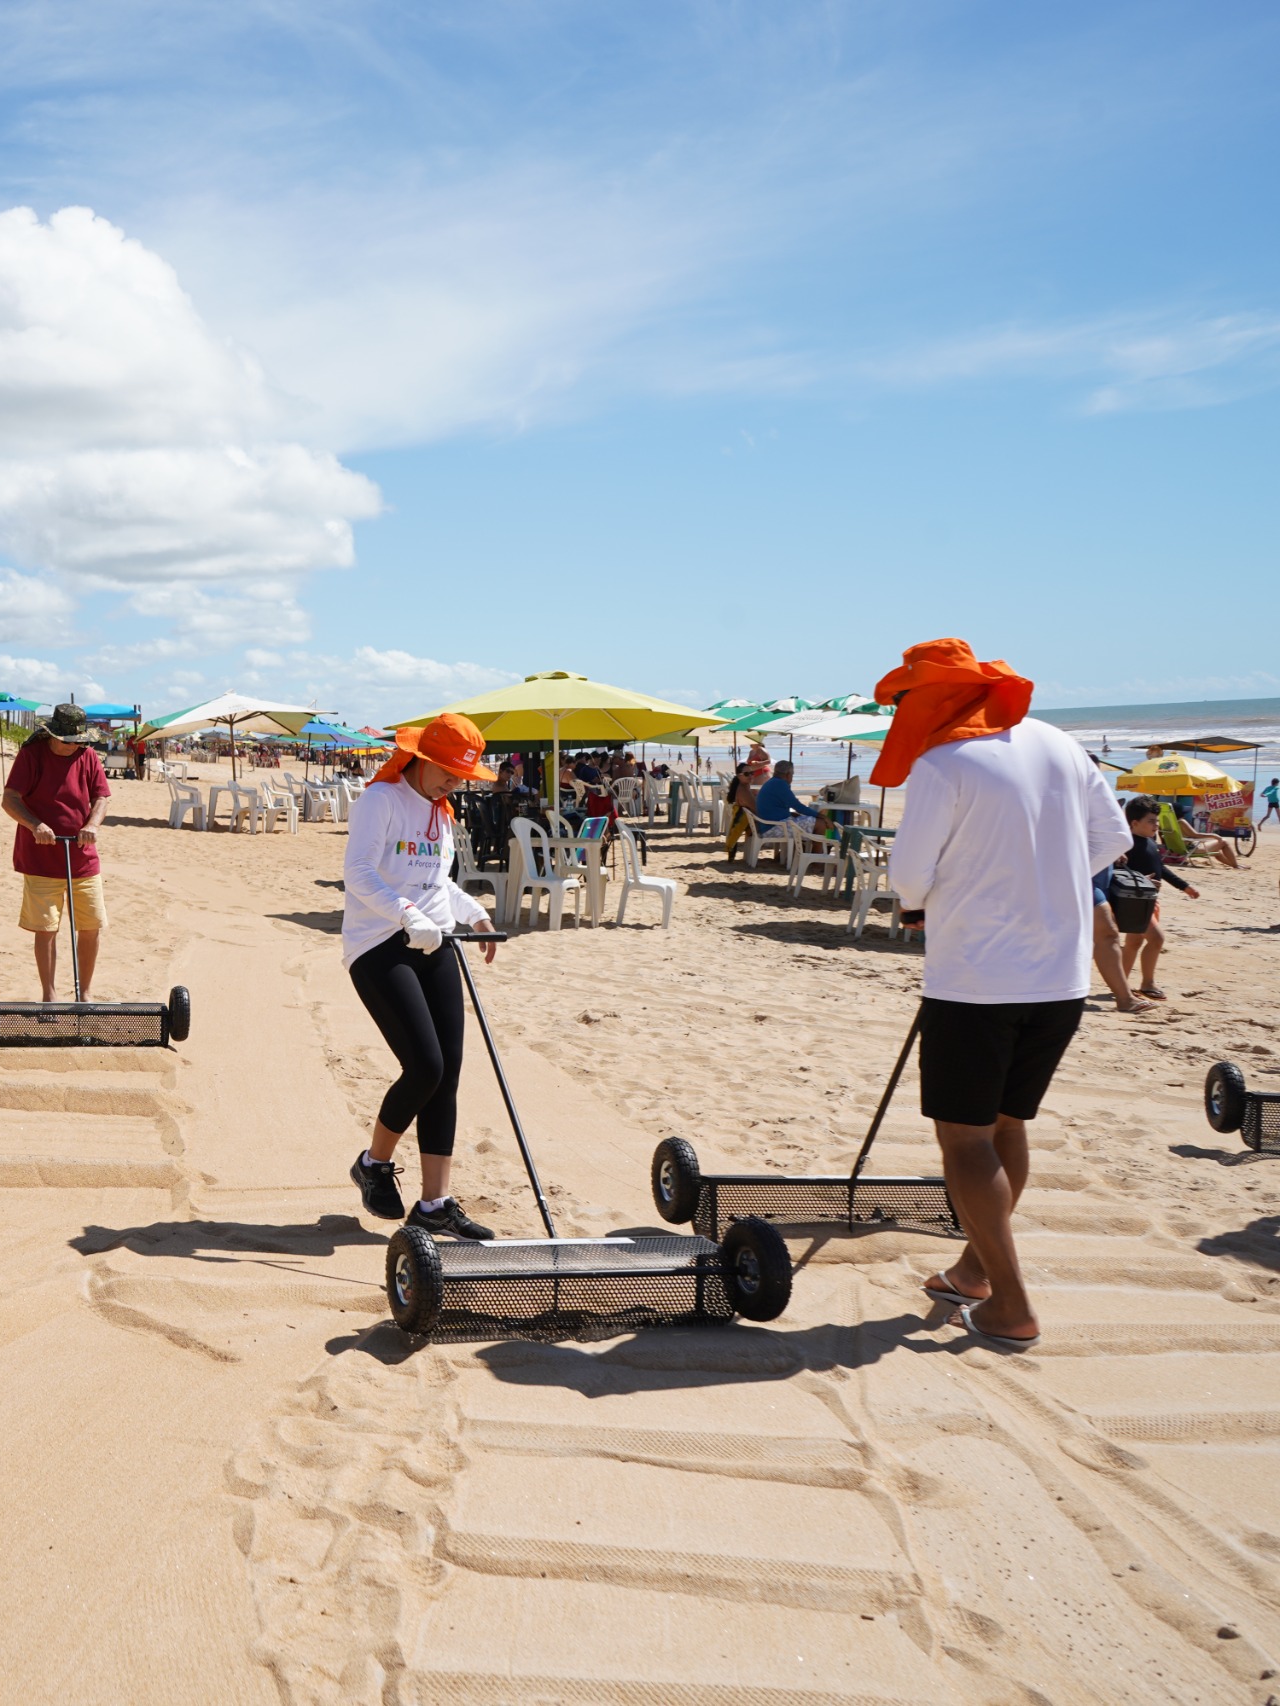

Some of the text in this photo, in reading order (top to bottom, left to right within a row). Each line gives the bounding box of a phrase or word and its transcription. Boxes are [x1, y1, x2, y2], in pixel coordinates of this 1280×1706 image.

[1207, 799, 1243, 811] Mania
[396, 841, 441, 857] PRAIA
[408, 859, 413, 867] A
[415, 859, 432, 868] Força
